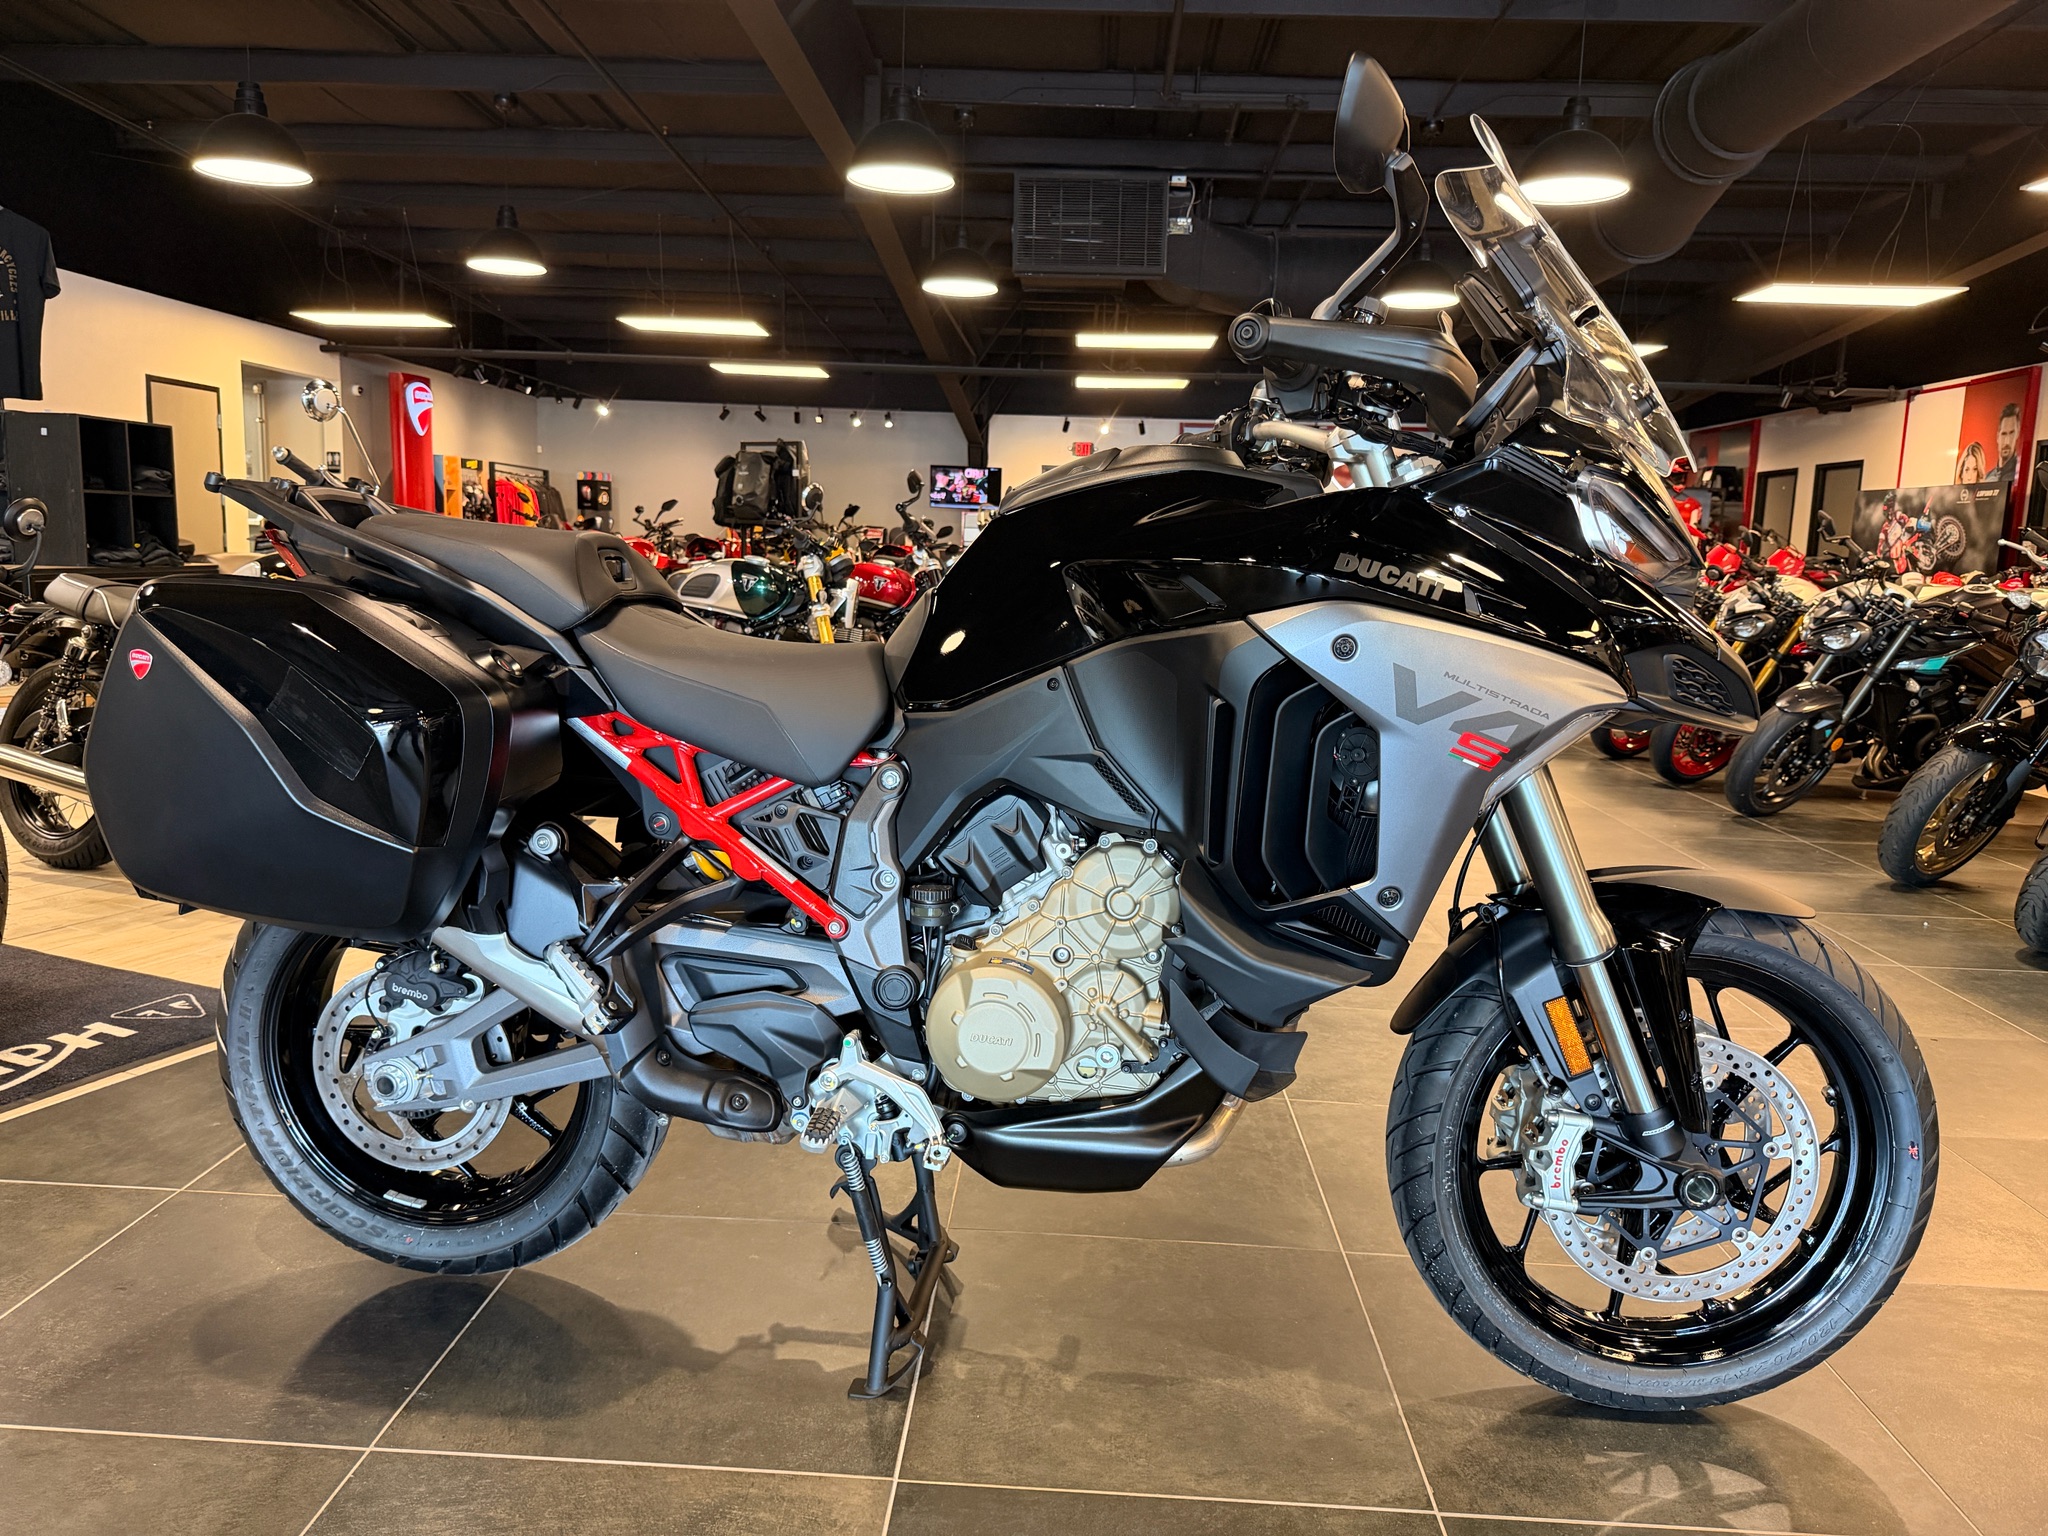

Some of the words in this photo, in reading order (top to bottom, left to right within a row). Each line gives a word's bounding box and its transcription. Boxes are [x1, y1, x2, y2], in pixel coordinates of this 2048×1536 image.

[1333, 552, 1445, 601] DUCATI
[1443, 671, 1550, 721] MULTISTRADA
[1449, 731, 1511, 768] S
[392, 982, 429, 1001] brembo
[0, 1021, 139, 1091] PH
[970, 1033, 1014, 1047] DUCATI
[1550, 1139, 1569, 1189] brembo
